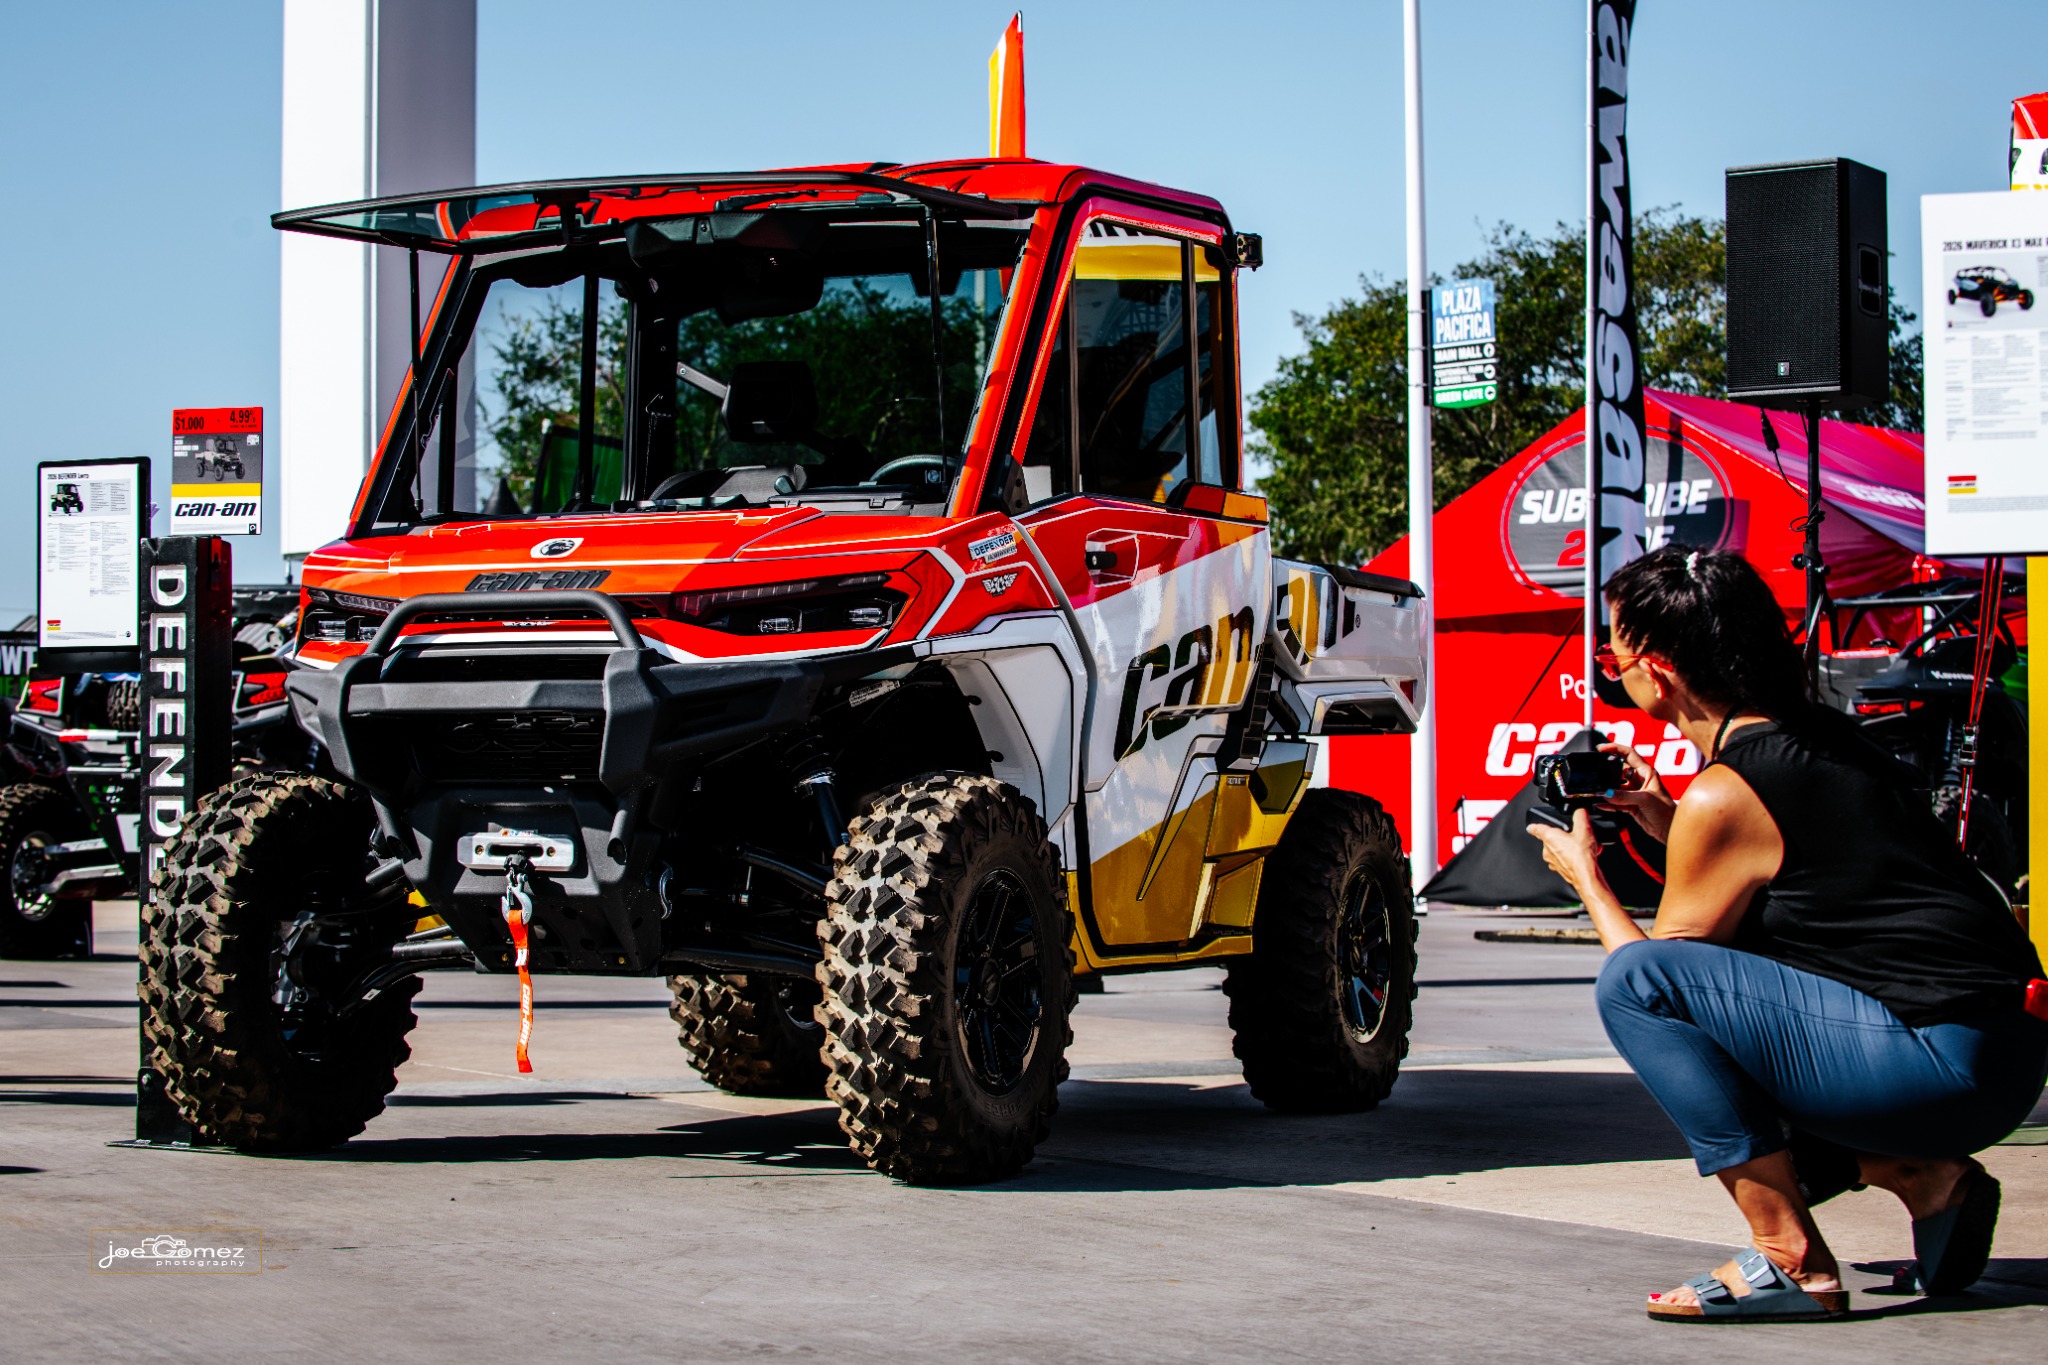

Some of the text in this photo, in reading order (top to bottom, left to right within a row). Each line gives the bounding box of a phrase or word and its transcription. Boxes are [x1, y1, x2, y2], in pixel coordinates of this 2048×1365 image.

[1441, 286, 1482, 316] PLAZA
[1435, 311, 1492, 343] PACIFICA
[174, 416, 205, 431] $1,000
[174, 502, 258, 518] can-am
[973, 532, 1015, 558] DEFENDER
[464, 569, 613, 593] can-am
[149, 564, 188, 902] DEFEND
[519, 982, 531, 1046] can-am
